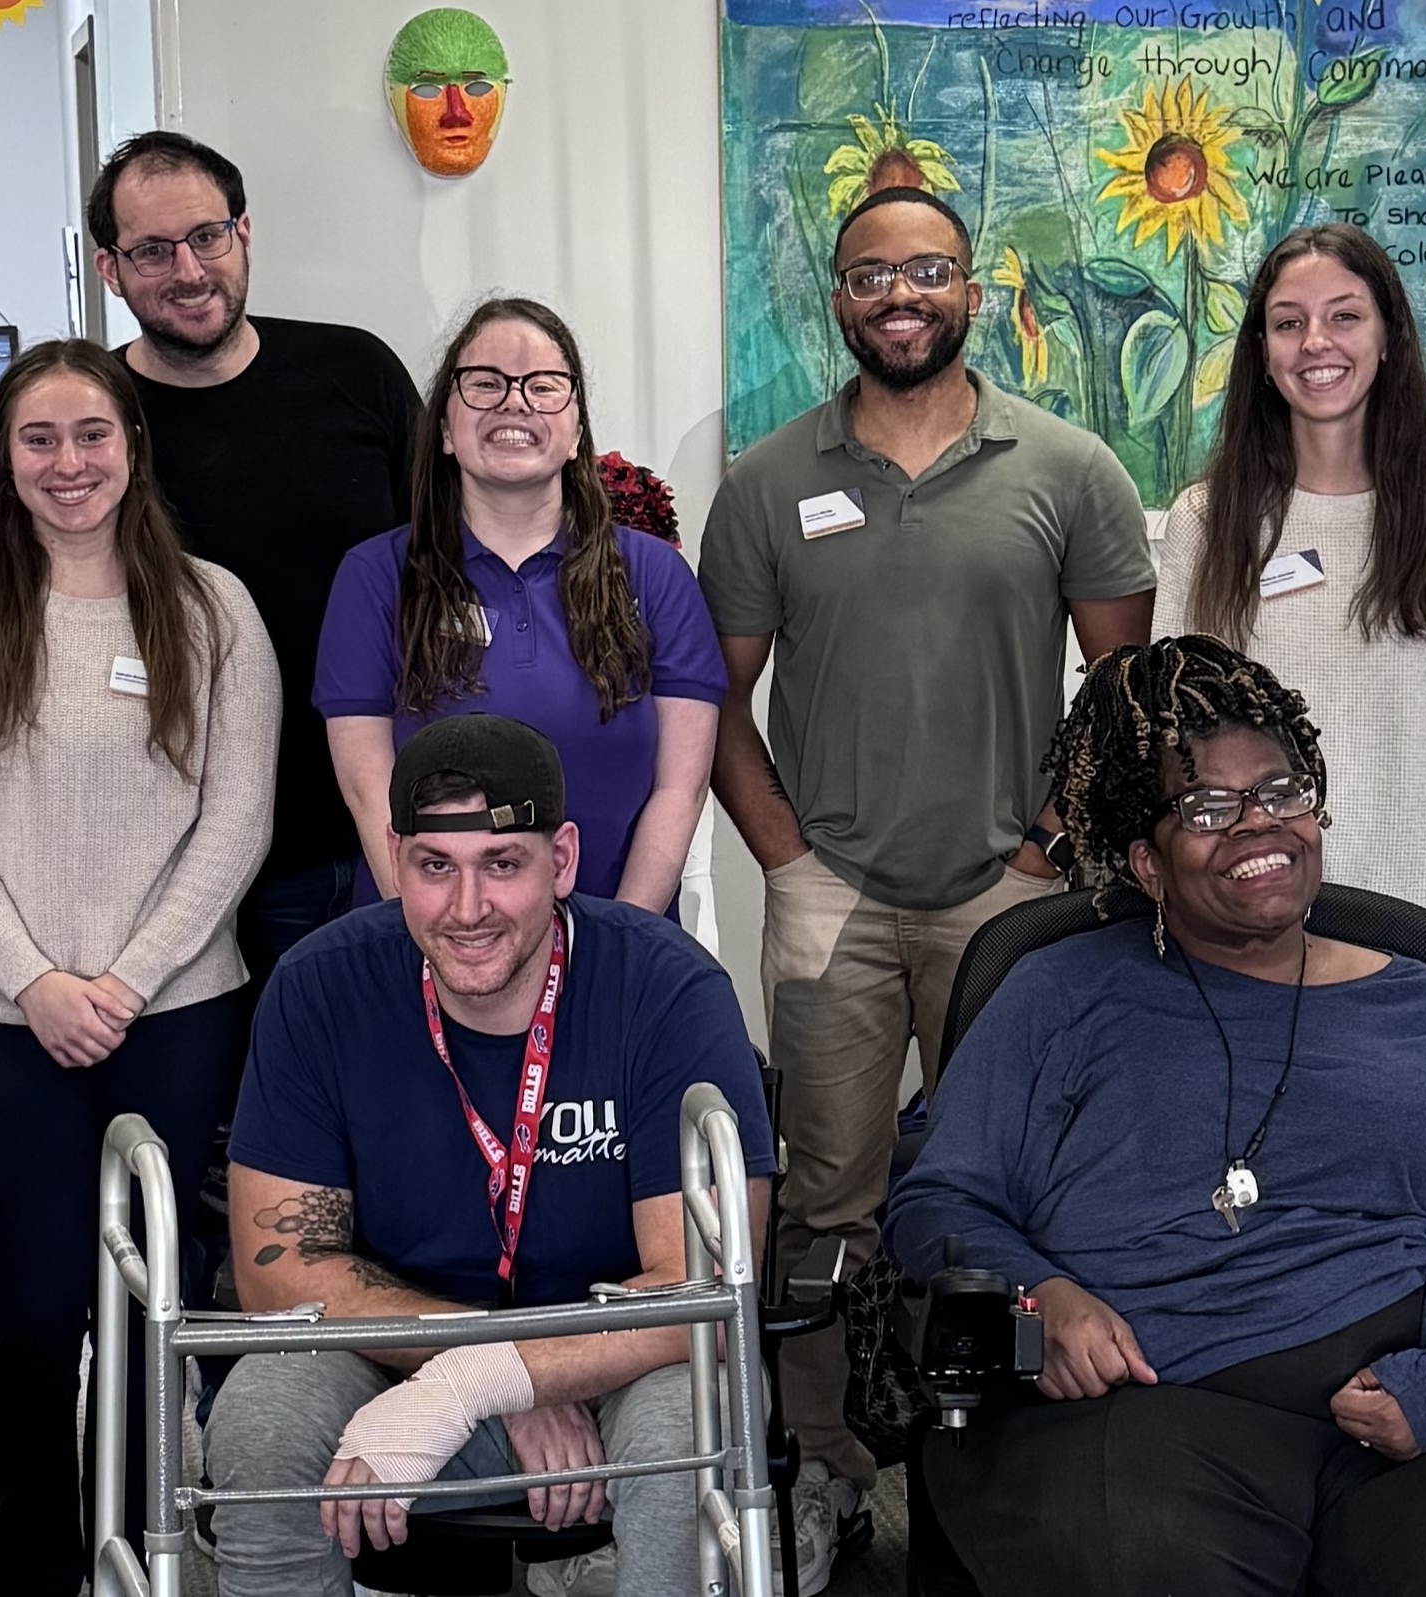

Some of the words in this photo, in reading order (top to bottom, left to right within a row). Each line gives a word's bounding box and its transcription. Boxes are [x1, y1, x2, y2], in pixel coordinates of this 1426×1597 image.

[1180, 3, 1296, 31] Growth
[1327, 1, 1385, 32] and
[996, 45, 1112, 88] Change
[1136, 44, 1272, 86] through
[1247, 160, 1291, 189] We
[1305, 166, 1354, 190] are
[540, 964, 561, 1014] BILLS
[522, 1063, 543, 1114] BILLS
[472, 1119, 506, 1163] BILLS
[533, 1129, 626, 1166] matte
[509, 1163, 526, 1214] BILLS
